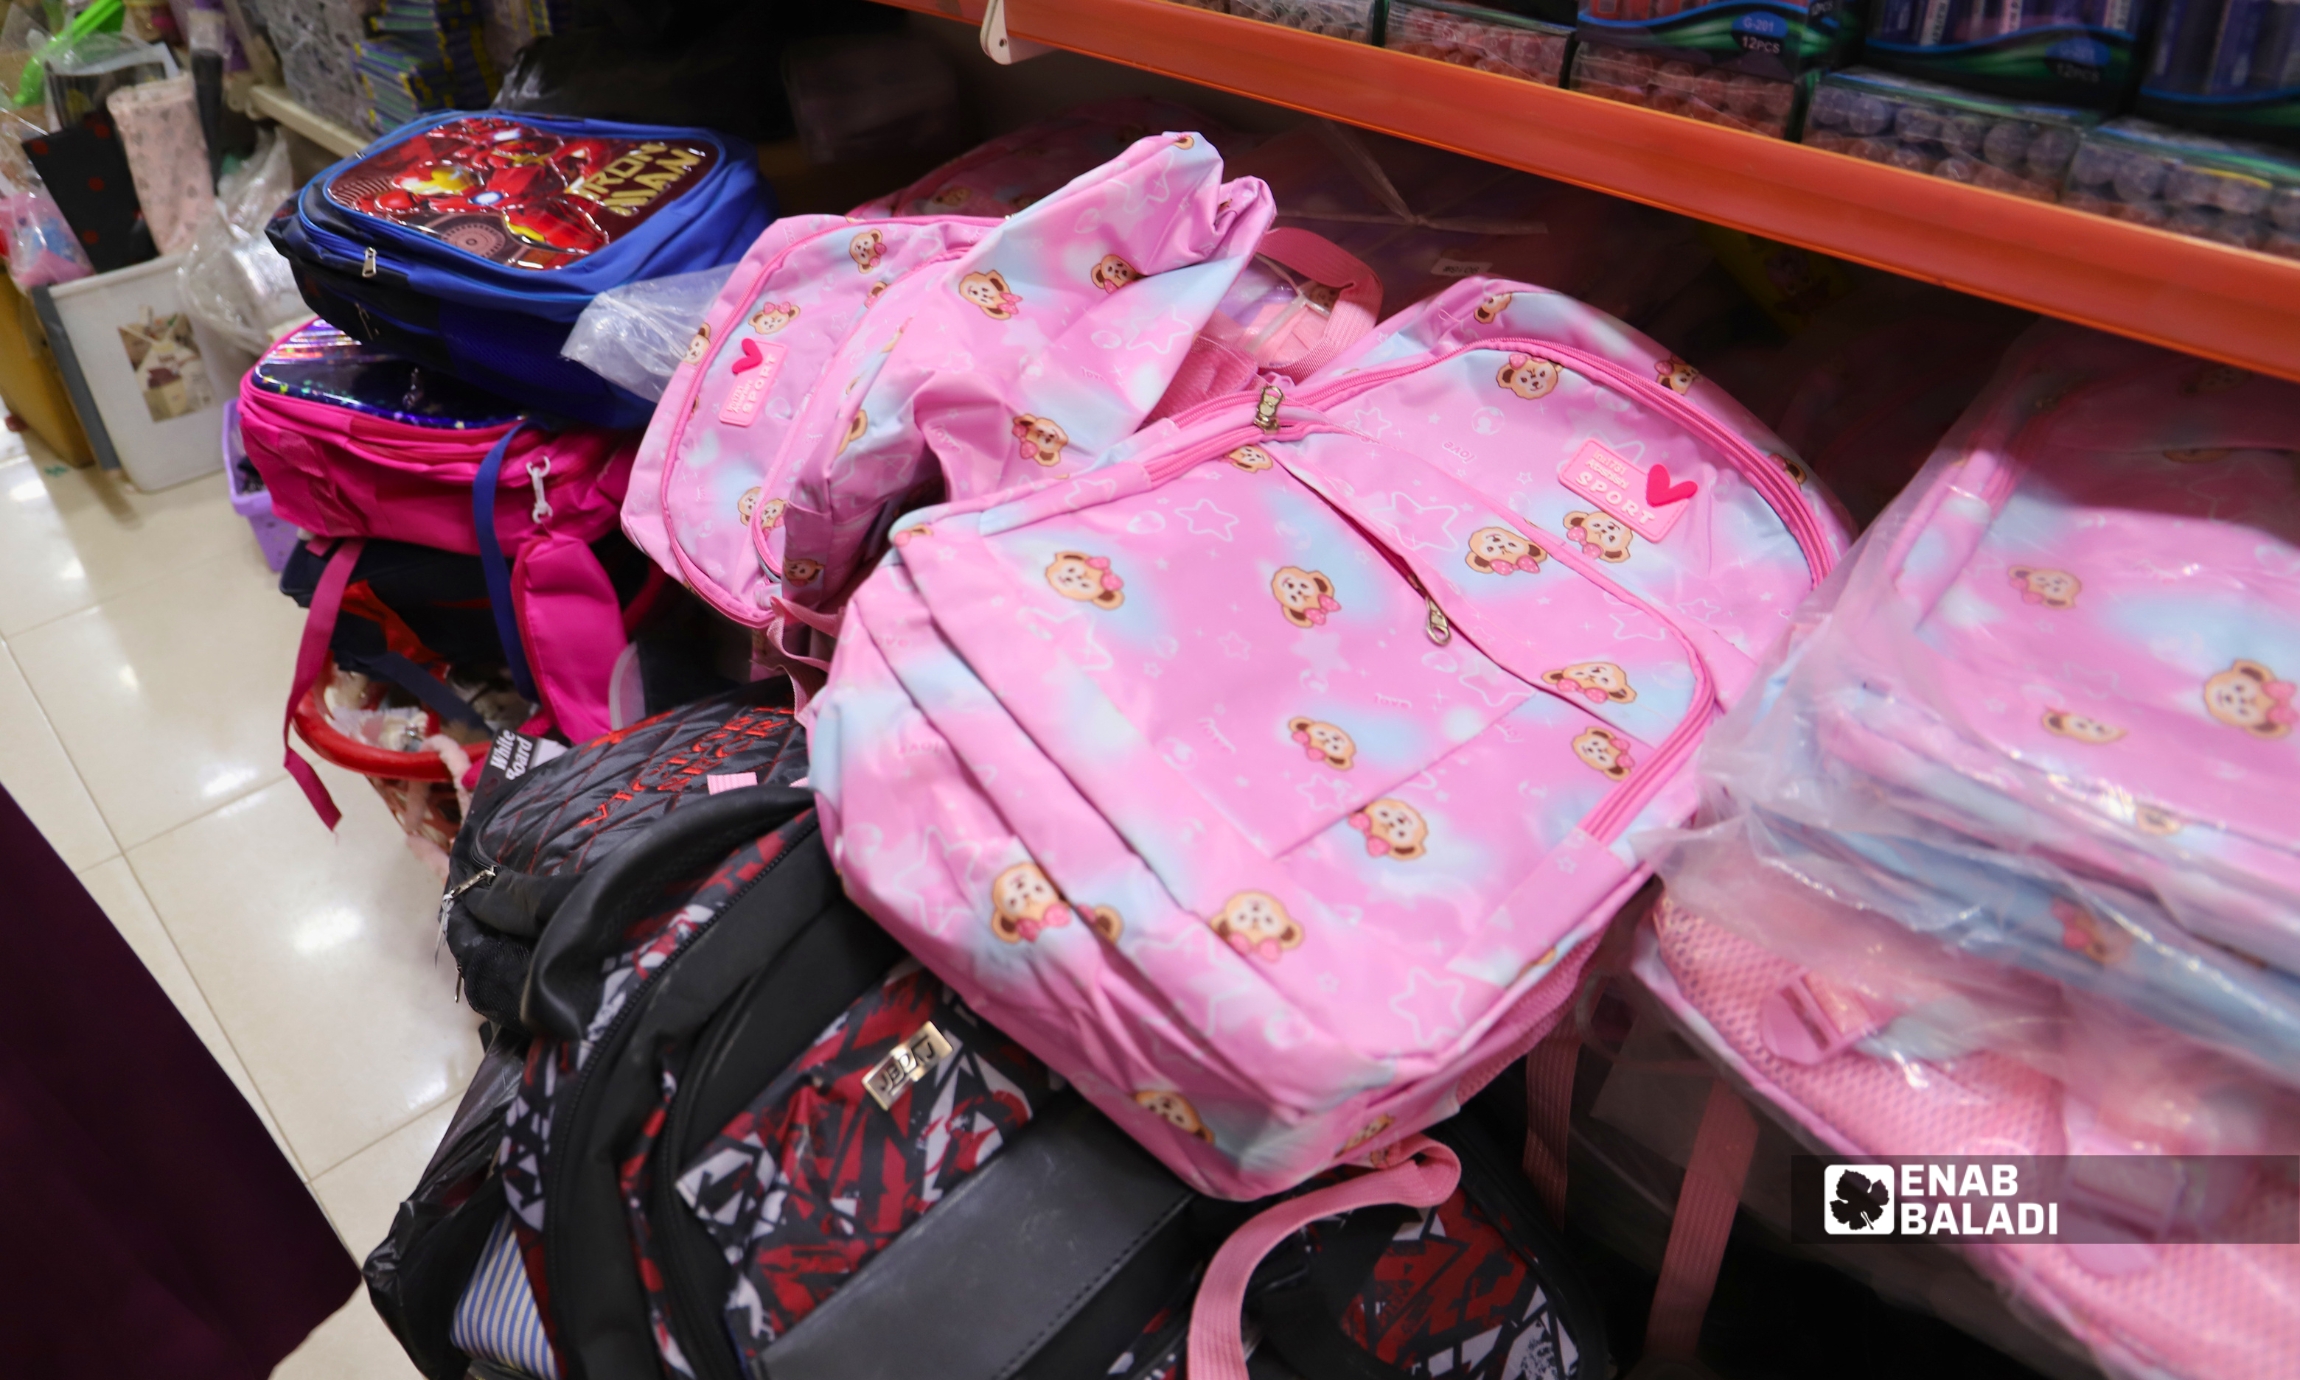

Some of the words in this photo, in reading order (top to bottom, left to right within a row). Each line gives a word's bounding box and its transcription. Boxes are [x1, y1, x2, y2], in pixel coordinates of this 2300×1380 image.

[1741, 35, 1781, 55] 12PCS
[579, 143, 668, 201] IRON
[602, 148, 701, 217] MAN
[741, 353, 777, 415] SPORT
[1441, 440, 1477, 463] love
[1575, 470, 1656, 525] SPORT
[489, 728, 516, 771] White
[504, 734, 534, 781] Board
[577, 706, 775, 828] VICTORI
